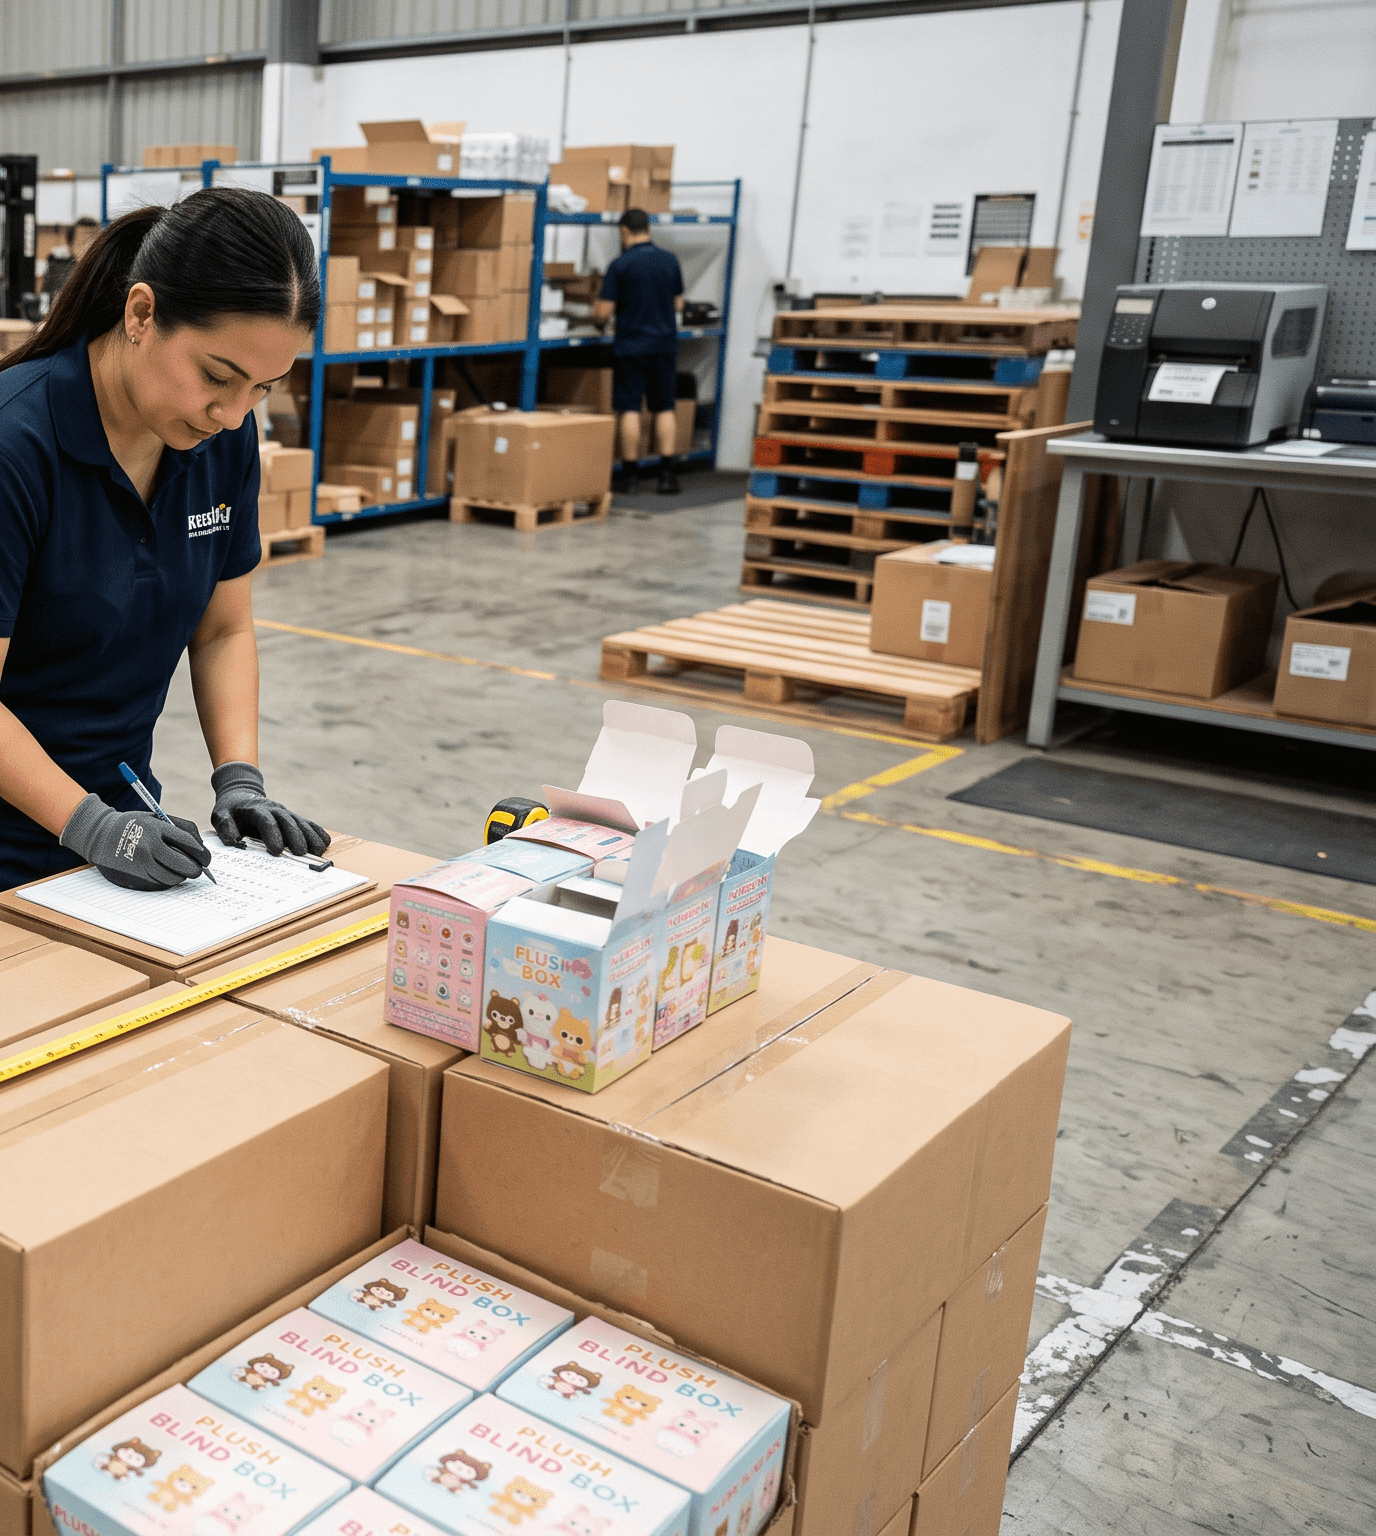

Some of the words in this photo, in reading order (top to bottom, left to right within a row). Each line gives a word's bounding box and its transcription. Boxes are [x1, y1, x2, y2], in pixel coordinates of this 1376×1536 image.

[522, 965, 561, 989] BOX
[390, 1259, 469, 1297] BLIND
[472, 1296, 531, 1326] BOX
[432, 1262, 513, 1301] PLUSH
[279, 1331, 359, 1373] BLIND
[362, 1373, 423, 1407] BOX
[323, 1334, 405, 1377] PLUSH
[578, 1340, 669, 1383] BLIND
[675, 1383, 743, 1417] BOX
[624, 1343, 716, 1388] PLUSH
[149, 1412, 230, 1461] BLIND
[233, 1460, 297, 1500] BOX
[195, 1416, 280, 1465] PLUSH
[517, 1427, 612, 1477] PLUSH
[469, 1423, 563, 1473] BLIND
[569, 1473, 639, 1513] BOX
